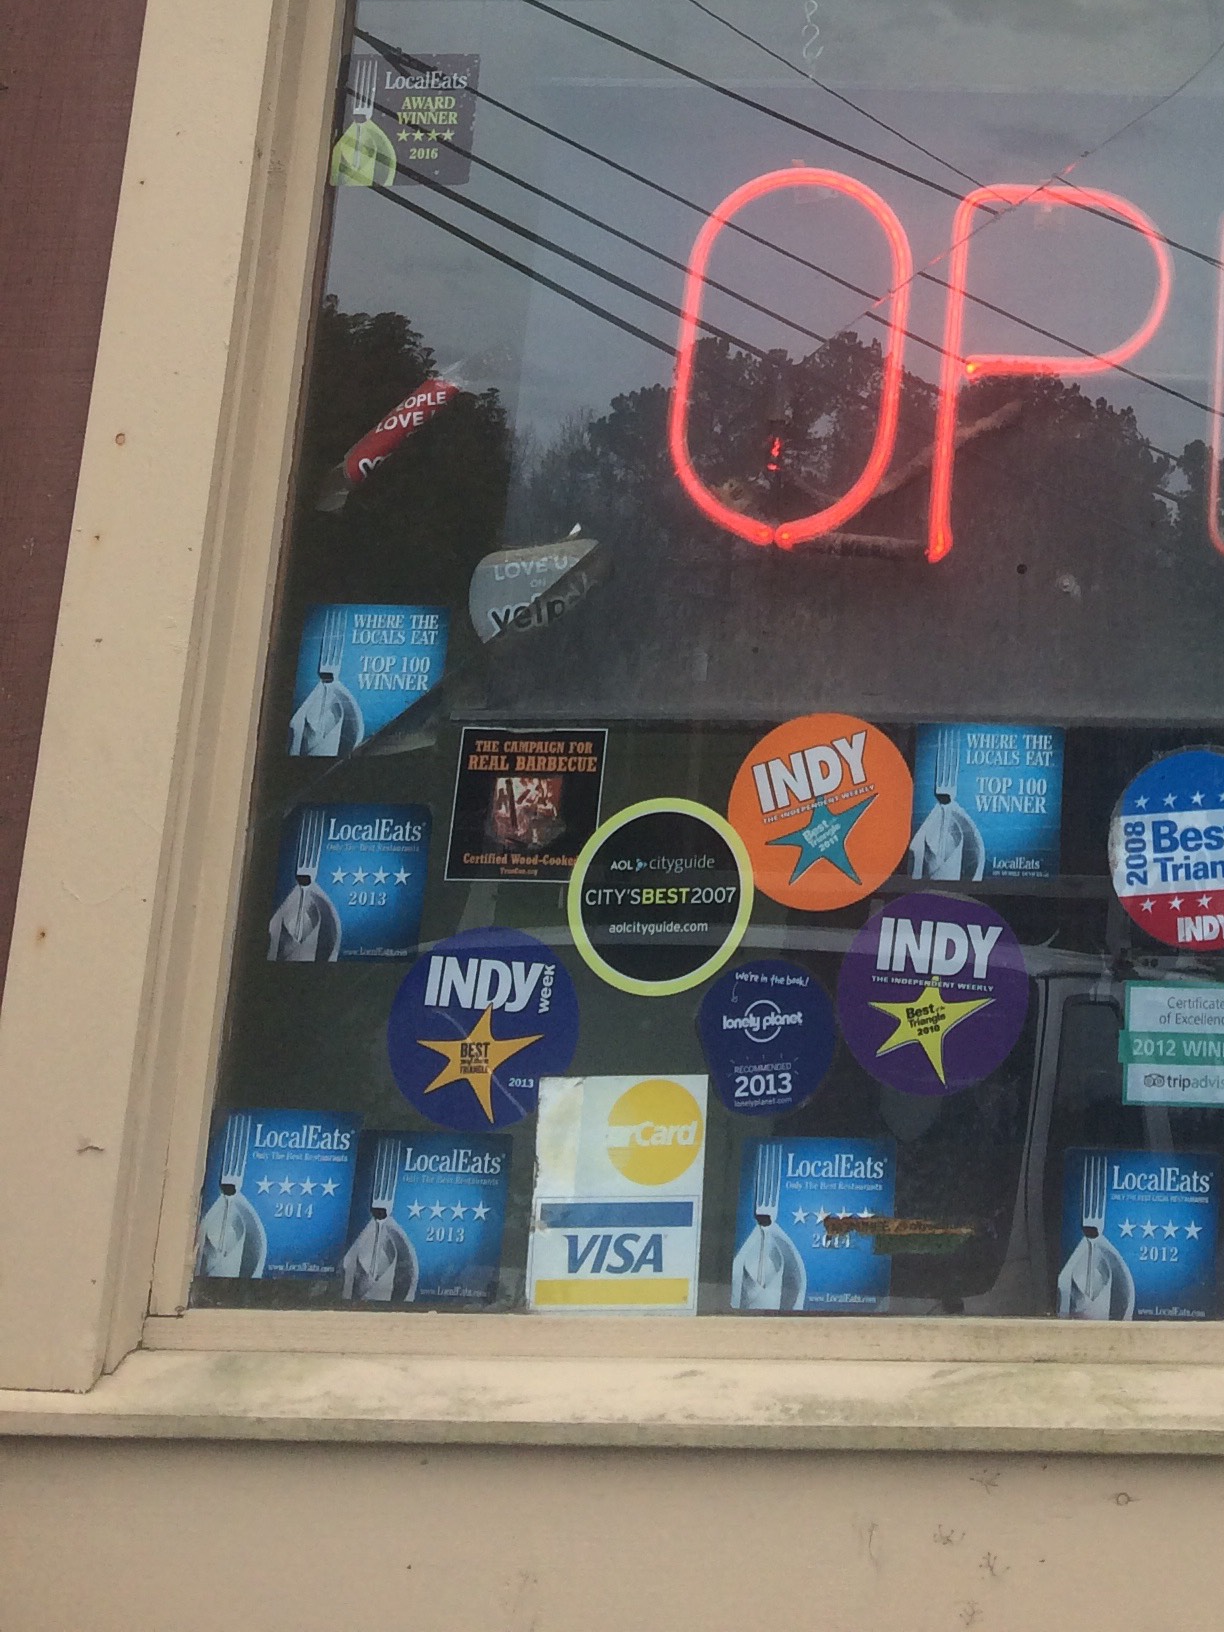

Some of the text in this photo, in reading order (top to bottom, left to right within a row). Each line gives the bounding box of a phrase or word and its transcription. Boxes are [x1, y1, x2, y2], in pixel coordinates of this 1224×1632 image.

[385, 71, 468, 90] LocalEats
[401, 96, 456, 110] AWARD
[397, 111, 458, 125] WINNER
[408, 148, 438, 160] 2016
[353, 614, 439, 631] WHERE THE
[352, 629, 438, 646] LOCALS EAT
[359, 656, 430, 674] TOP 100
[357, 673, 429, 691] WINNER
[475, 740, 593, 754] THE CAMPAIGN FOR
[966, 733, 1053, 750] WHERE THE
[468, 754, 598, 772] REAL BARBECUE
[966, 750, 1020, 766] LOCALS
[751, 729, 869, 814] INDY
[975, 777, 1047, 796] TOP 100
[975, 795, 1047, 814] WINNER
[328, 818, 422, 842] LocalEats
[463, 853, 507, 864] Certified
[1123, 821, 1148, 886] 2008
[610, 855, 715, 873] AOL cityguide
[992, 856, 1040, 870] LocalEats
[348, 891, 387, 906] 2013
[608, 921, 709, 935] aolcityguide.com
[876, 916, 1003, 979] INDY
[424, 955, 556, 1014] INDY week
[905, 1003, 935, 1019] Best
[1159, 1012, 1172, 1025] of
[722, 1011, 803, 1031] lonely planet
[917, 1024, 940, 1036] 2010
[460, 1042, 490, 1058] BEST
[1132, 1038, 1176, 1057] 2012
[508, 1077, 534, 1088] 2013
[734, 1072, 793, 1097] 2013
[254, 1123, 350, 1150] LocalEats
[404, 1147, 501, 1175] LocalEats
[786, 1153, 884, 1179] LocalEats
[1112, 1165, 1211, 1193] LocalEats
[274, 1203, 313, 1218] 2014
[425, 1226, 465, 1243] 2013
[563, 1233, 664, 1274] VISA
[1139, 1246, 1178, 1262] 2012
